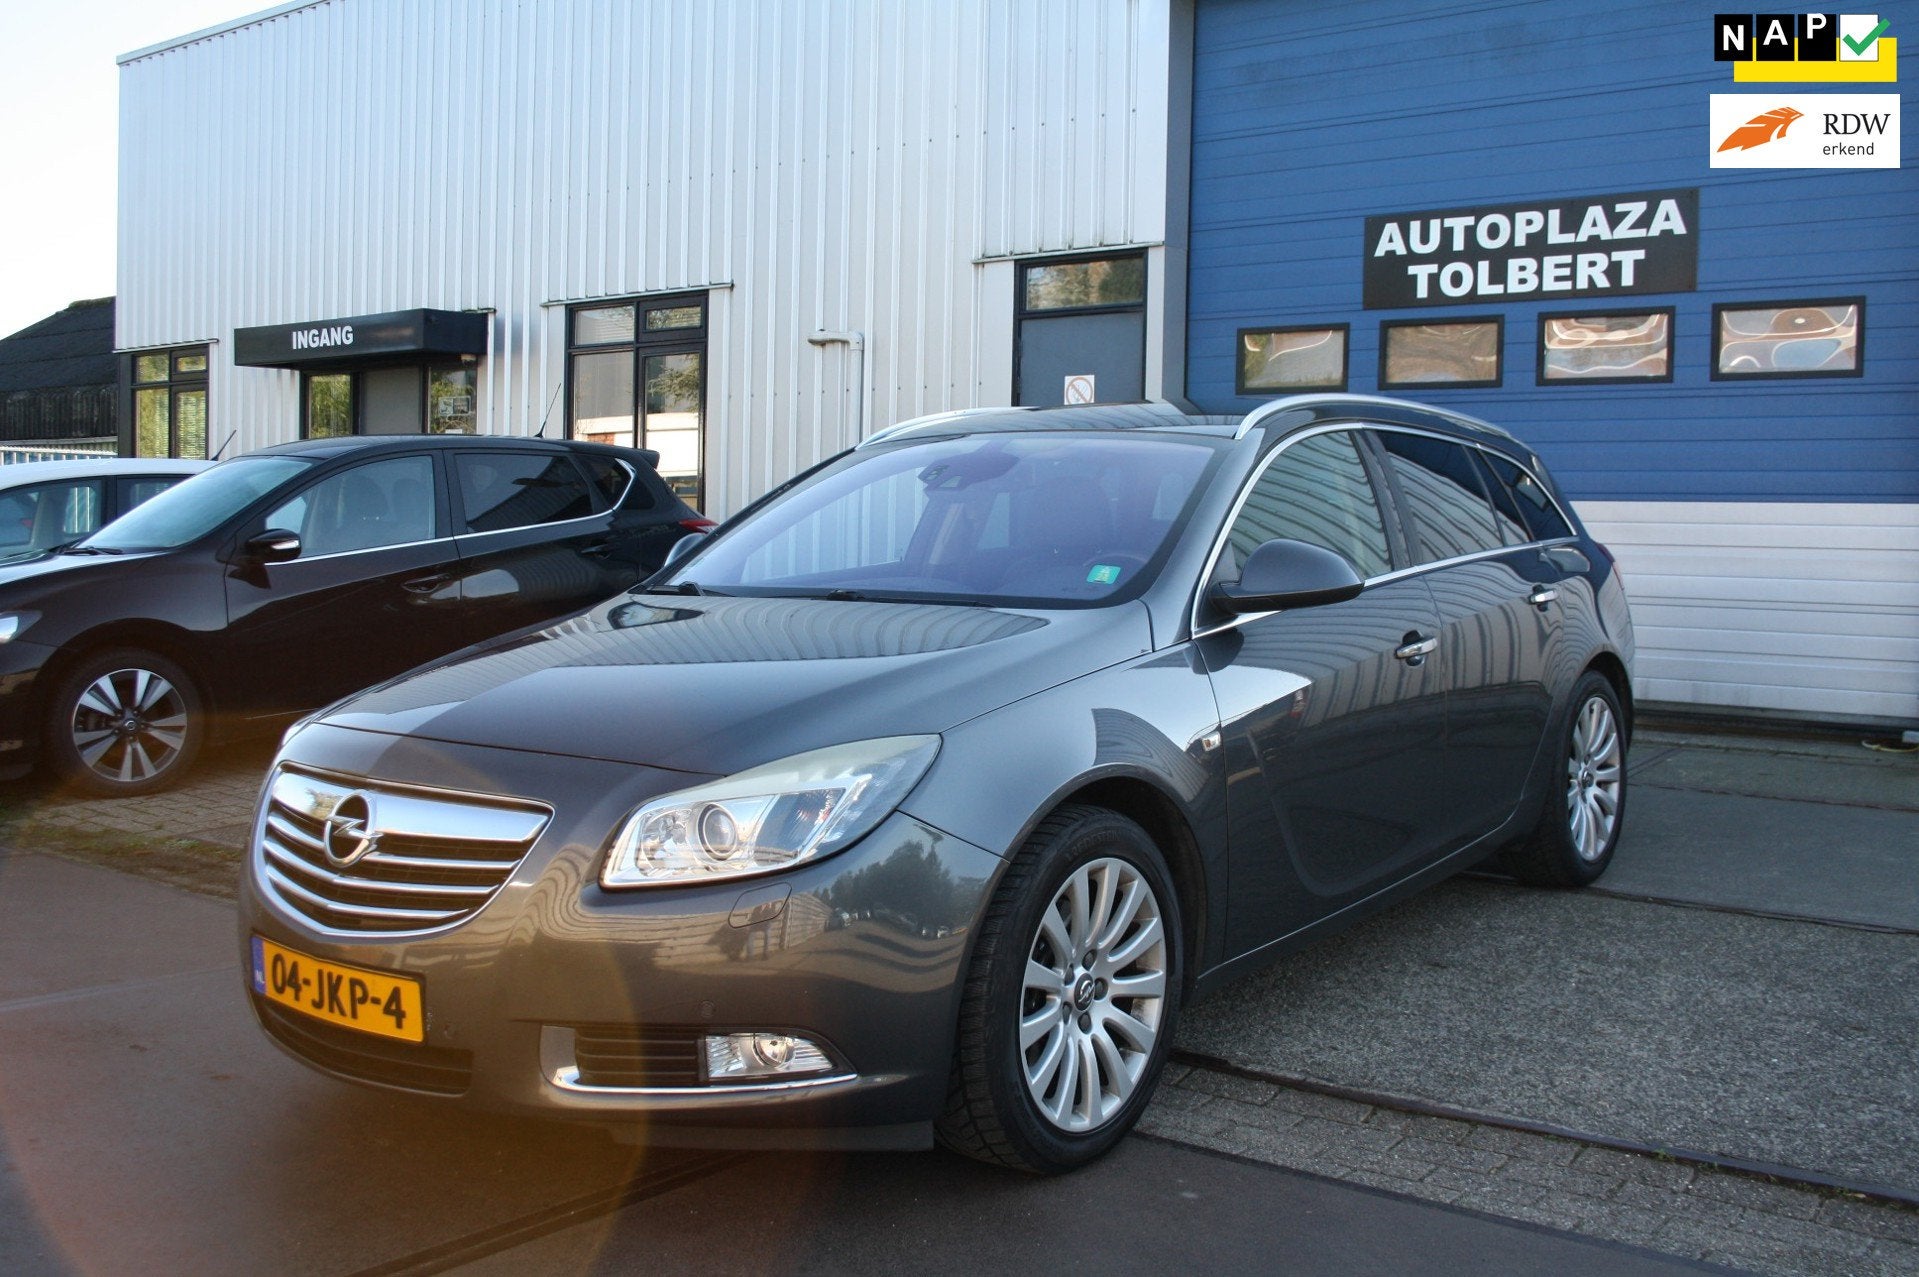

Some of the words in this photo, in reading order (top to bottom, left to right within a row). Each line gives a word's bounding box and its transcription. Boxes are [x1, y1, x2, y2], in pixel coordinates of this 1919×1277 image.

[1374, 198, 1687, 258] AUTOPLAZA
[1408, 249, 1646, 299] TOLBERT
[292, 325, 354, 350] INGANG
[272, 953, 406, 1030] 04-JKP-4
